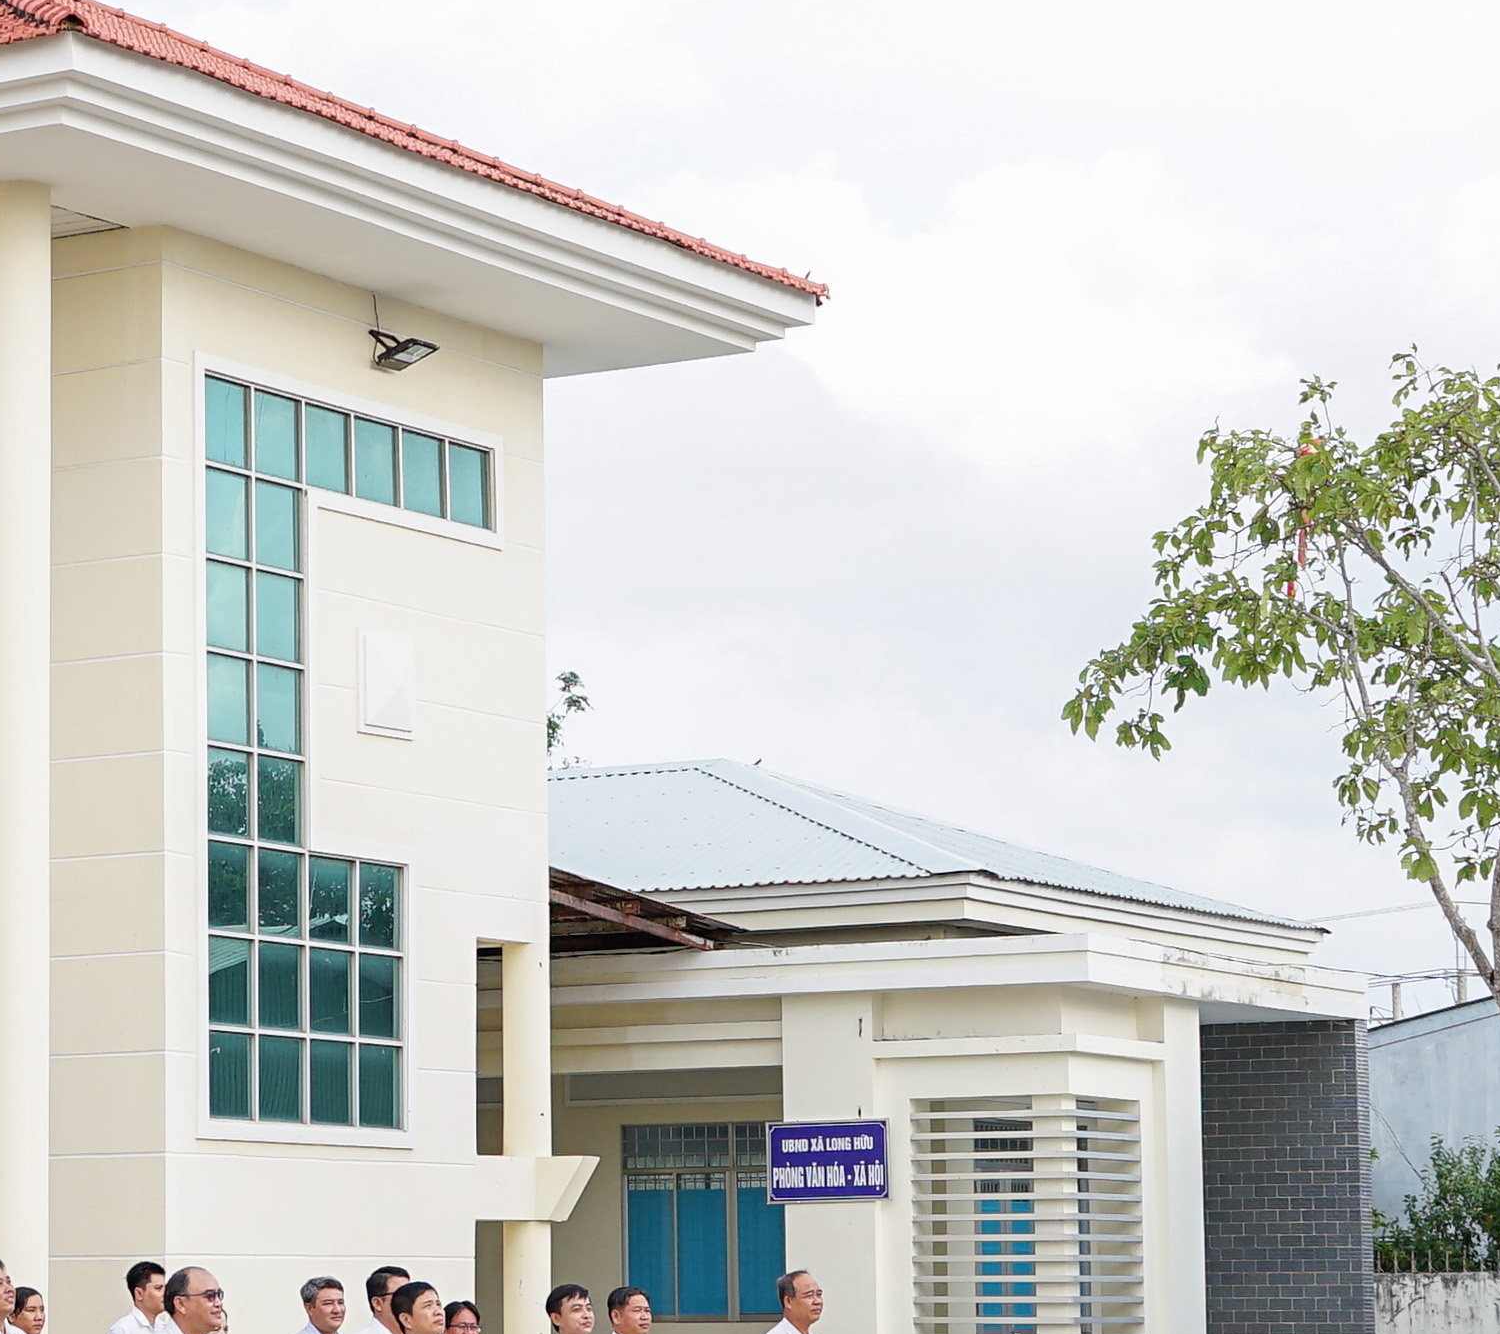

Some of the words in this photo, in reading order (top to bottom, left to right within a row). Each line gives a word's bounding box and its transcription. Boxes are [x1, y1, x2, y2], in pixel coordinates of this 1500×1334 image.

[782, 1138, 809, 1153] UBND
[810, 1135, 824, 1152] XÃ
[826, 1137, 852, 1151] LONG
[853, 1134, 874, 1150] HỮU
[773, 1161, 805, 1189] PHÒNG
[805, 1161, 825, 1188] VĂN
[826, 1161, 846, 1187] HÓA
[853, 1160, 867, 1186] XÃ
[868, 1159, 884, 1191] HỘI
